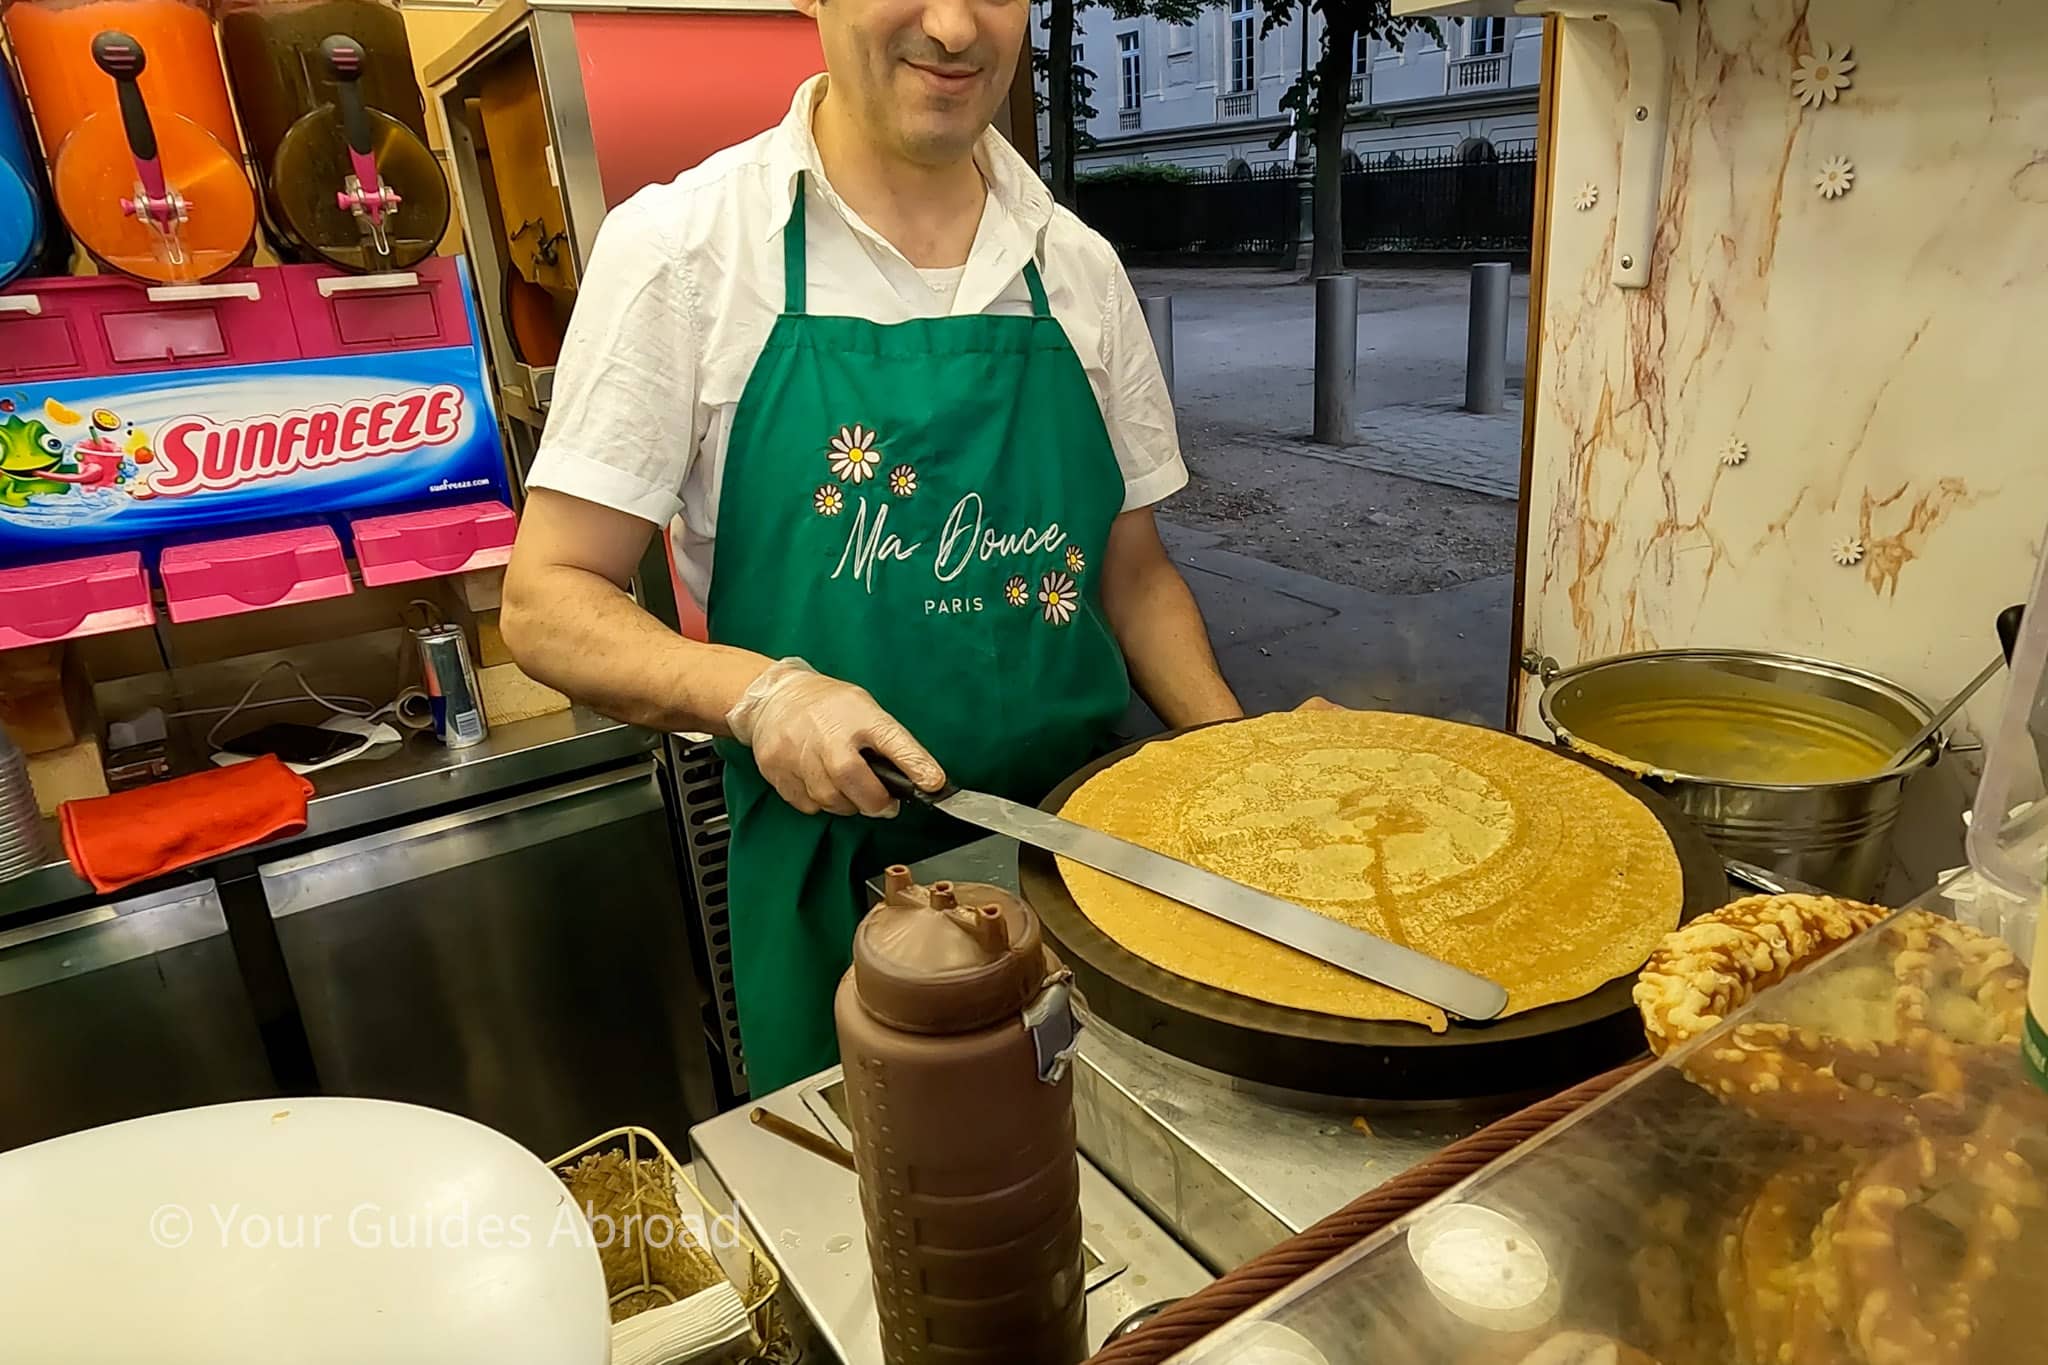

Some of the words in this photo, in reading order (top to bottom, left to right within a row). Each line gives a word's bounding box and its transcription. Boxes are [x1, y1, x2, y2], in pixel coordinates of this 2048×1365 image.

[156, 390, 456, 489] SUNFREEZE
[830, 496, 922, 594] Ma
[934, 492, 1067, 582] Douce
[923, 597, 984, 615] PARIS
